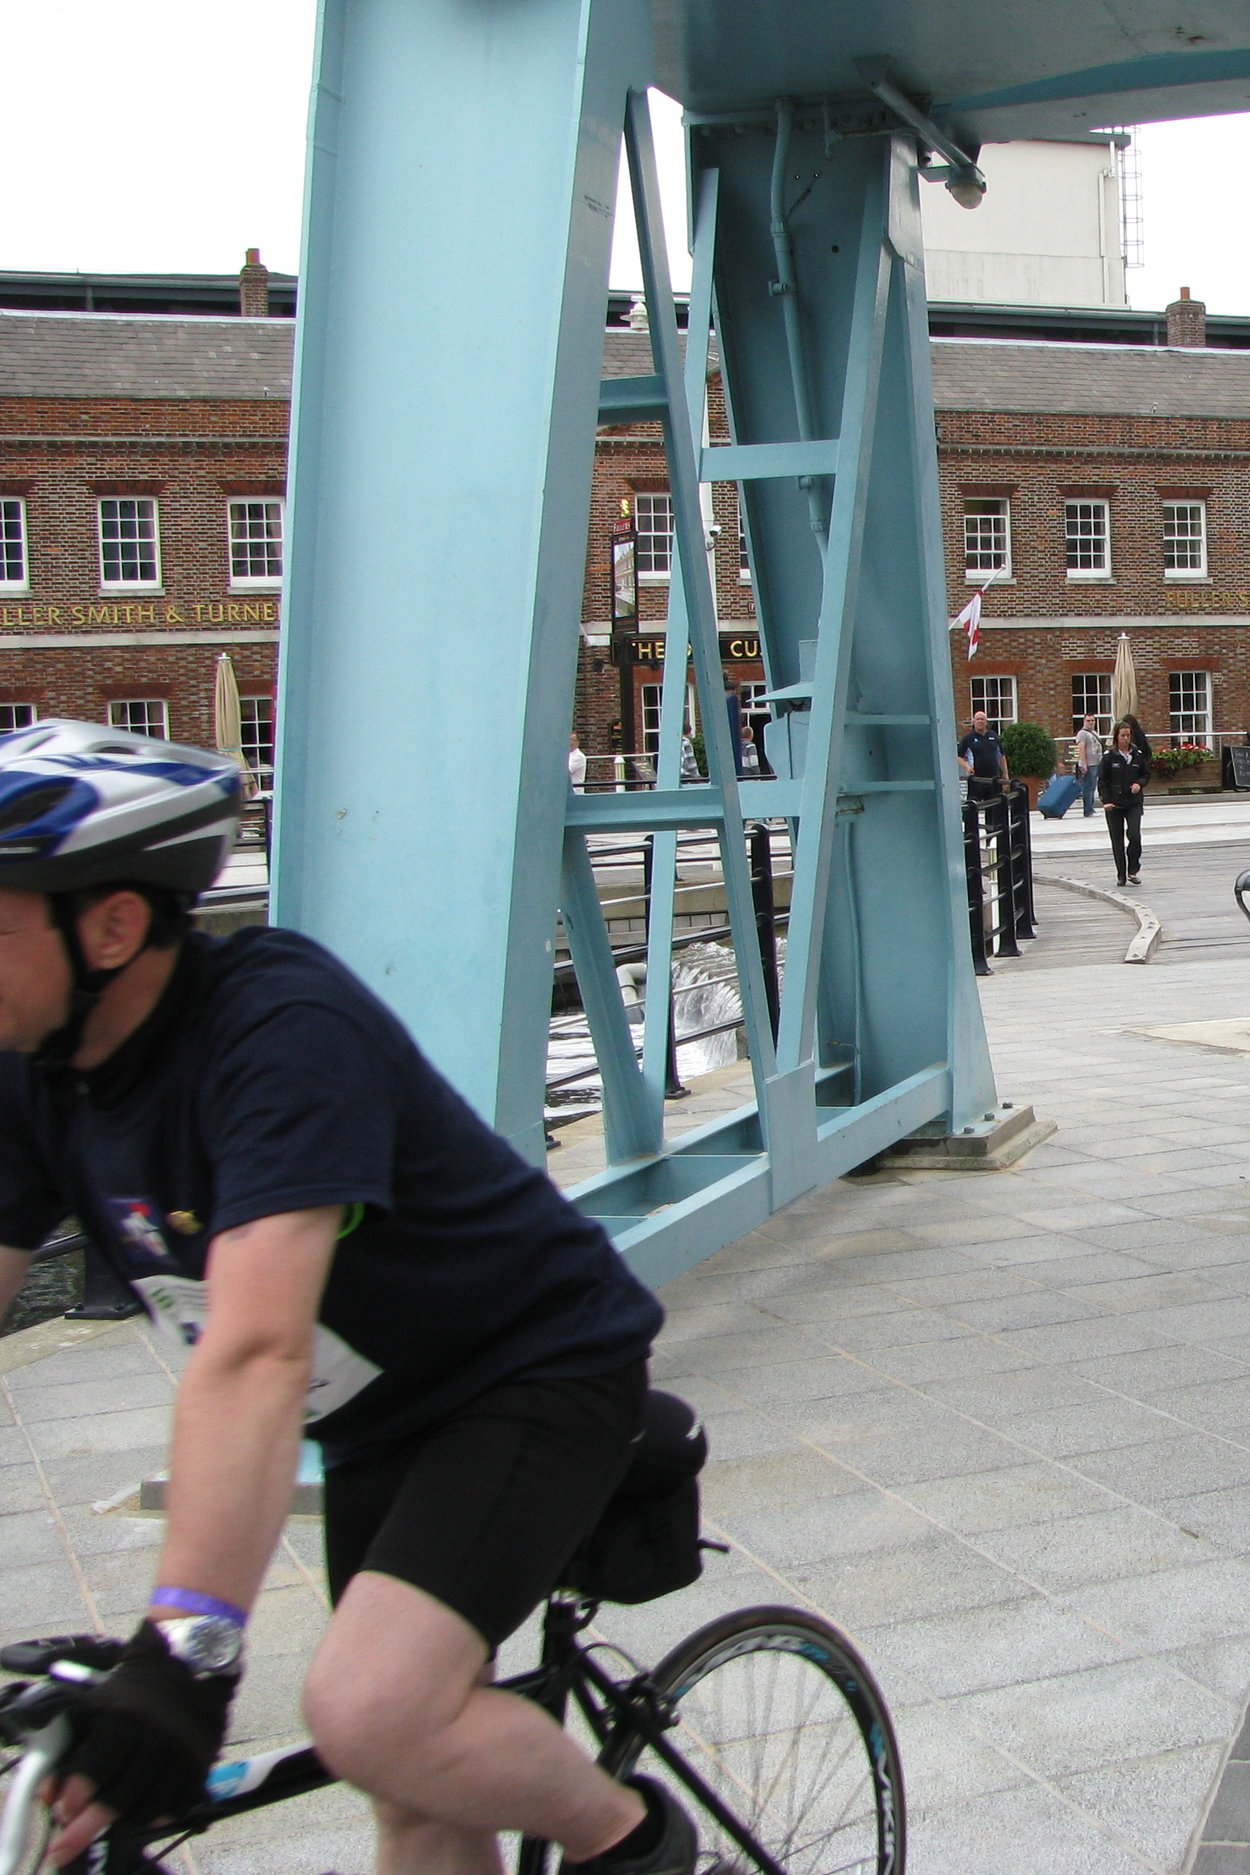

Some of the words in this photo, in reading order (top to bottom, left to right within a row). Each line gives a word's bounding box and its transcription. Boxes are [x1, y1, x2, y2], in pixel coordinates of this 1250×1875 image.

[71, 605, 154, 625] SMITH
[166, 604, 184, 624] &
[192, 602, 281, 623] TURNE
[631, 641, 665, 660] HE
[730, 641, 764, 657] CU
